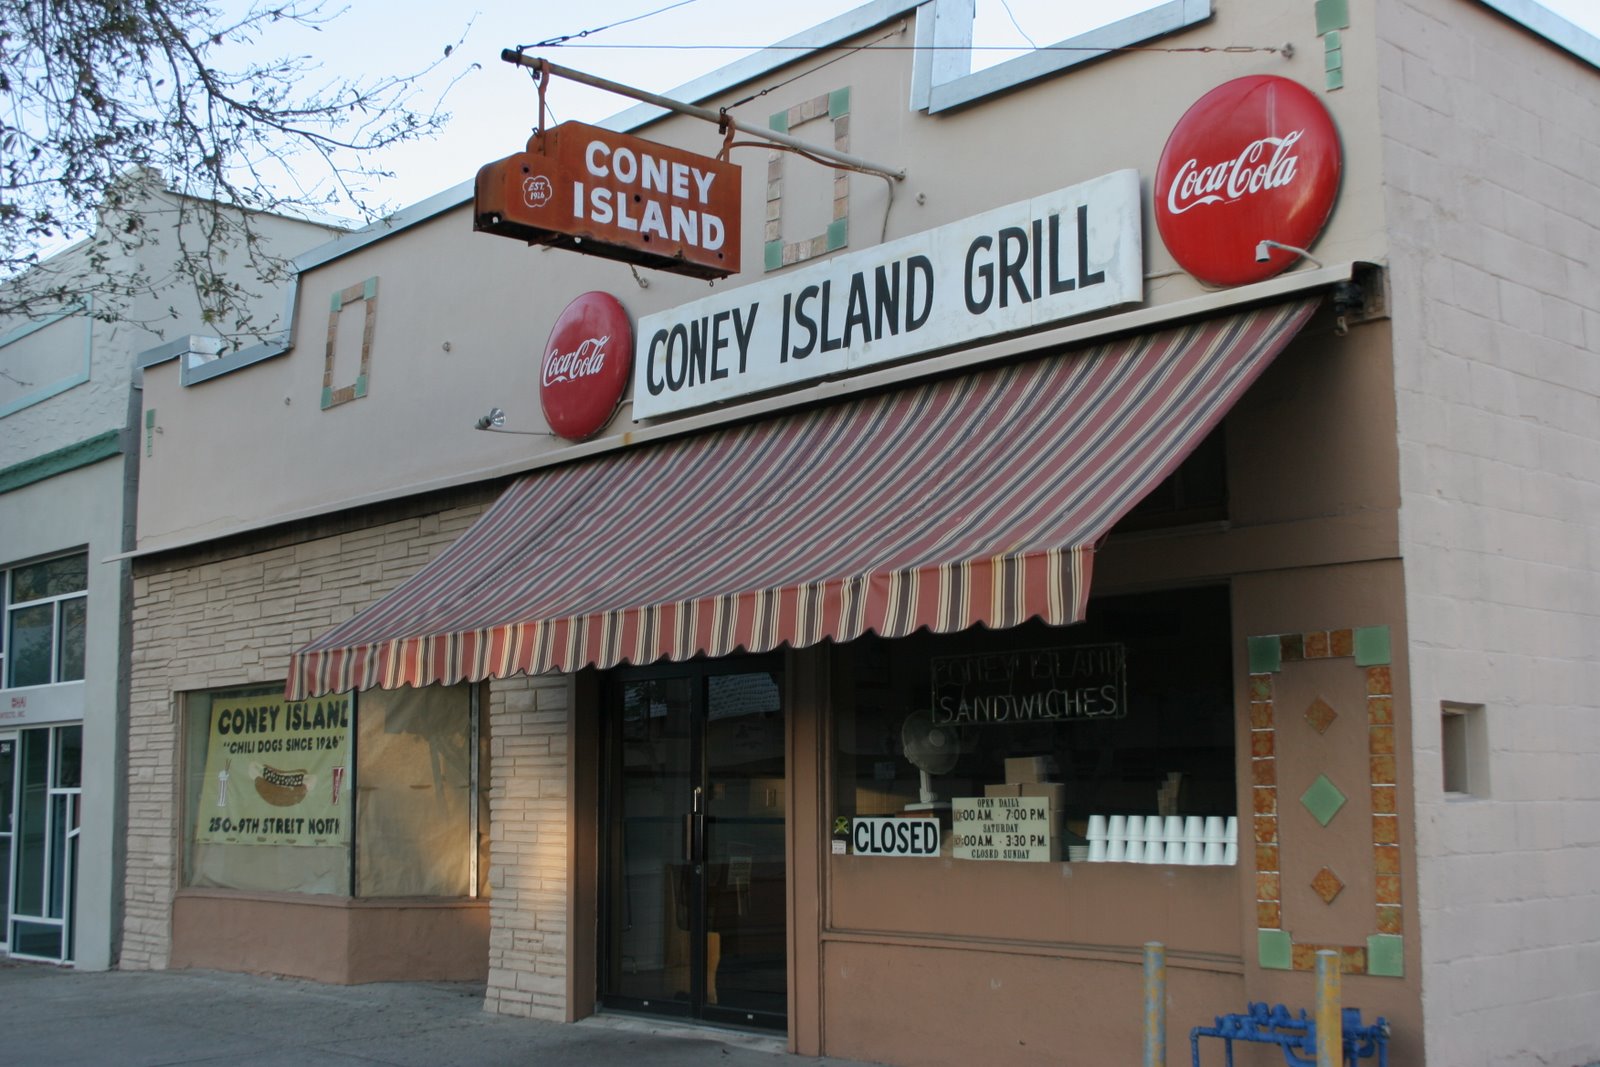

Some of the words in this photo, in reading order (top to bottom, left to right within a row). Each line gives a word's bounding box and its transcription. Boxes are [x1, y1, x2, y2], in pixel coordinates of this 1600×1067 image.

[585, 140, 716, 204] CONEY
[1168, 128, 1305, 214] Coca-Cola
[573, 181, 725, 251] ISLAND
[646, 302, 759, 396] CONEY
[780, 254, 935, 364] ISLAND
[964, 203, 1105, 315] GRILL
[543, 335, 611, 387] Coca-Cola
[939, 685, 1118, 724] SANDWICHES
[218, 706, 280, 735] CONEY
[257, 739, 283, 753] DOGS
[286, 737, 313, 751] SINCE
[977, 798, 994, 808] OPEN
[999, 798, 1020, 807] DAILY
[1006, 809, 1027, 820] 7:00
[1030, 809, 1047, 820] P.M.
[854, 821, 938, 854] CLOSED
[983, 823, 1018, 833] SATURDAY
[1006, 835, 1026, 846] 3:30
[1030, 835, 1047, 847] P.M.
[971, 849, 999, 858] CLOSED
[1003, 849, 1030, 859] SUNDAY
